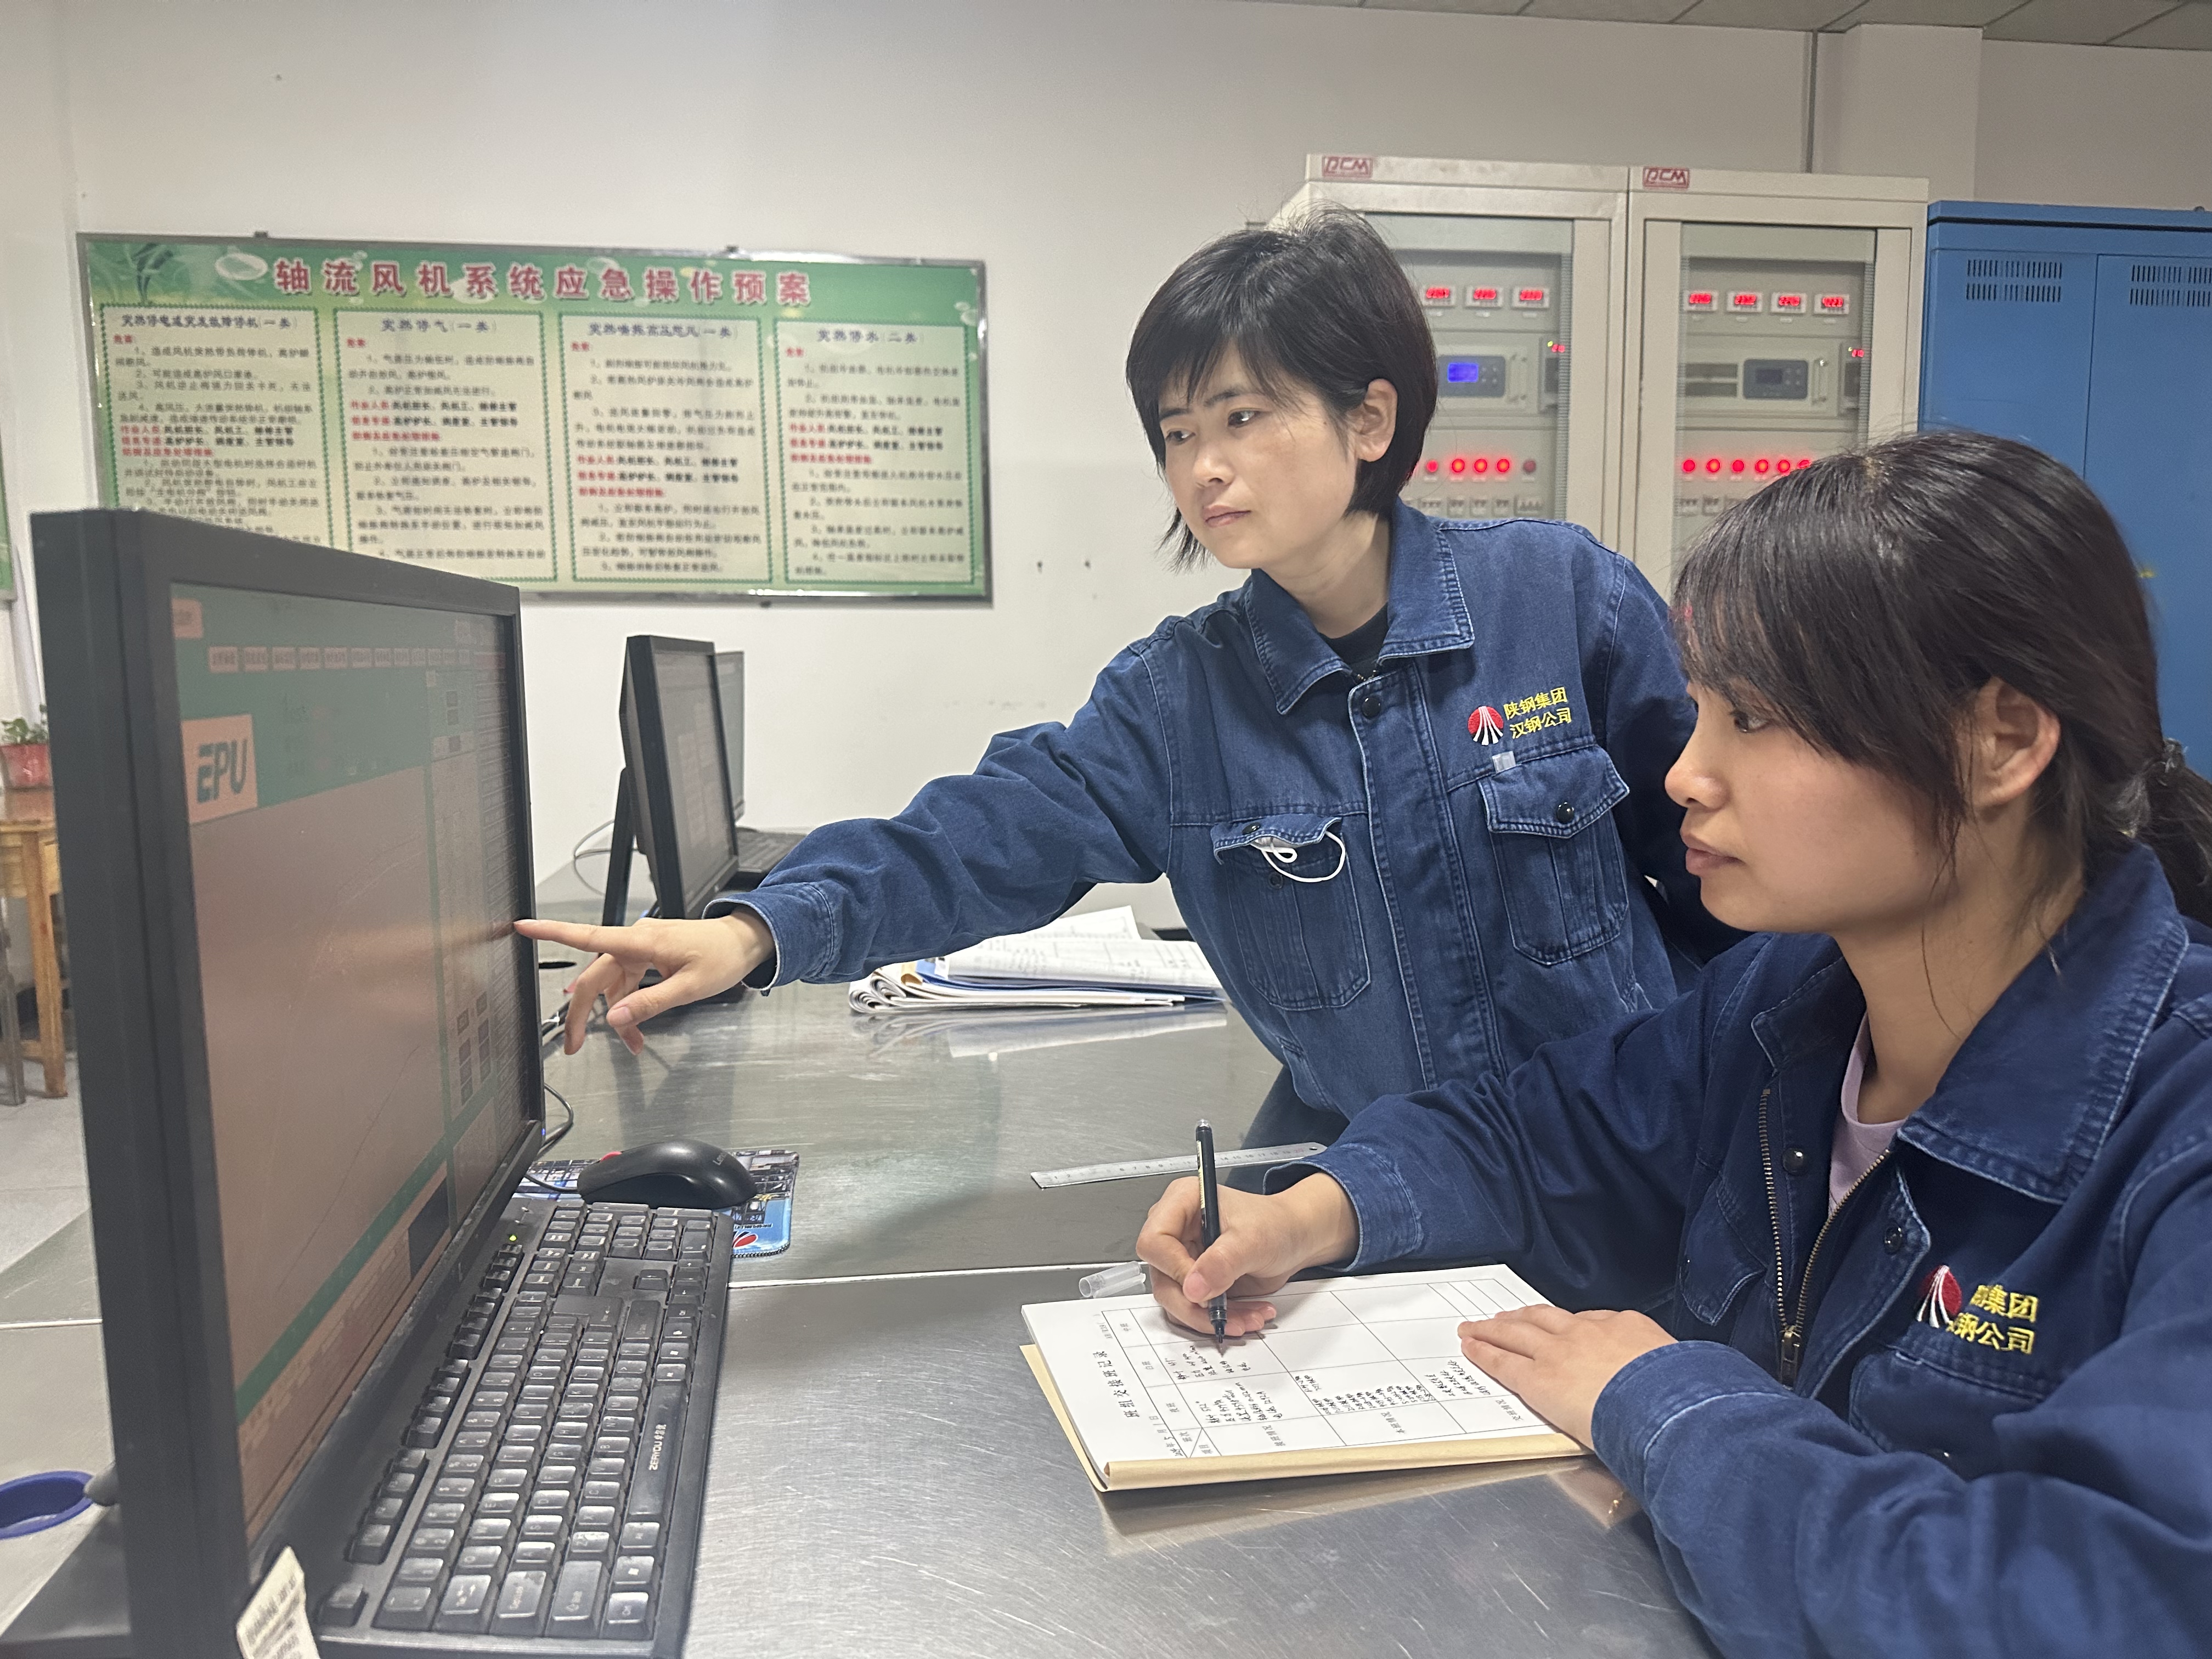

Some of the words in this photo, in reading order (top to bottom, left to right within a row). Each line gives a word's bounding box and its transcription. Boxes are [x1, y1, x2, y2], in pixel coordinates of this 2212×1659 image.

[275, 259, 811, 305] 轴流风机系统应急操作预案
[1503, 686, 1568, 720] 陕钢集团
[1509, 707, 1572, 739] 汉钢公司
[1092, 1351, 1140, 1418] 班组交接班记录
[1380, 1411, 1406, 1434] 本班情况
[1495, 1399, 1523, 1421] 交班情况
[1261, 1425, 1286, 1447] 接班情况
